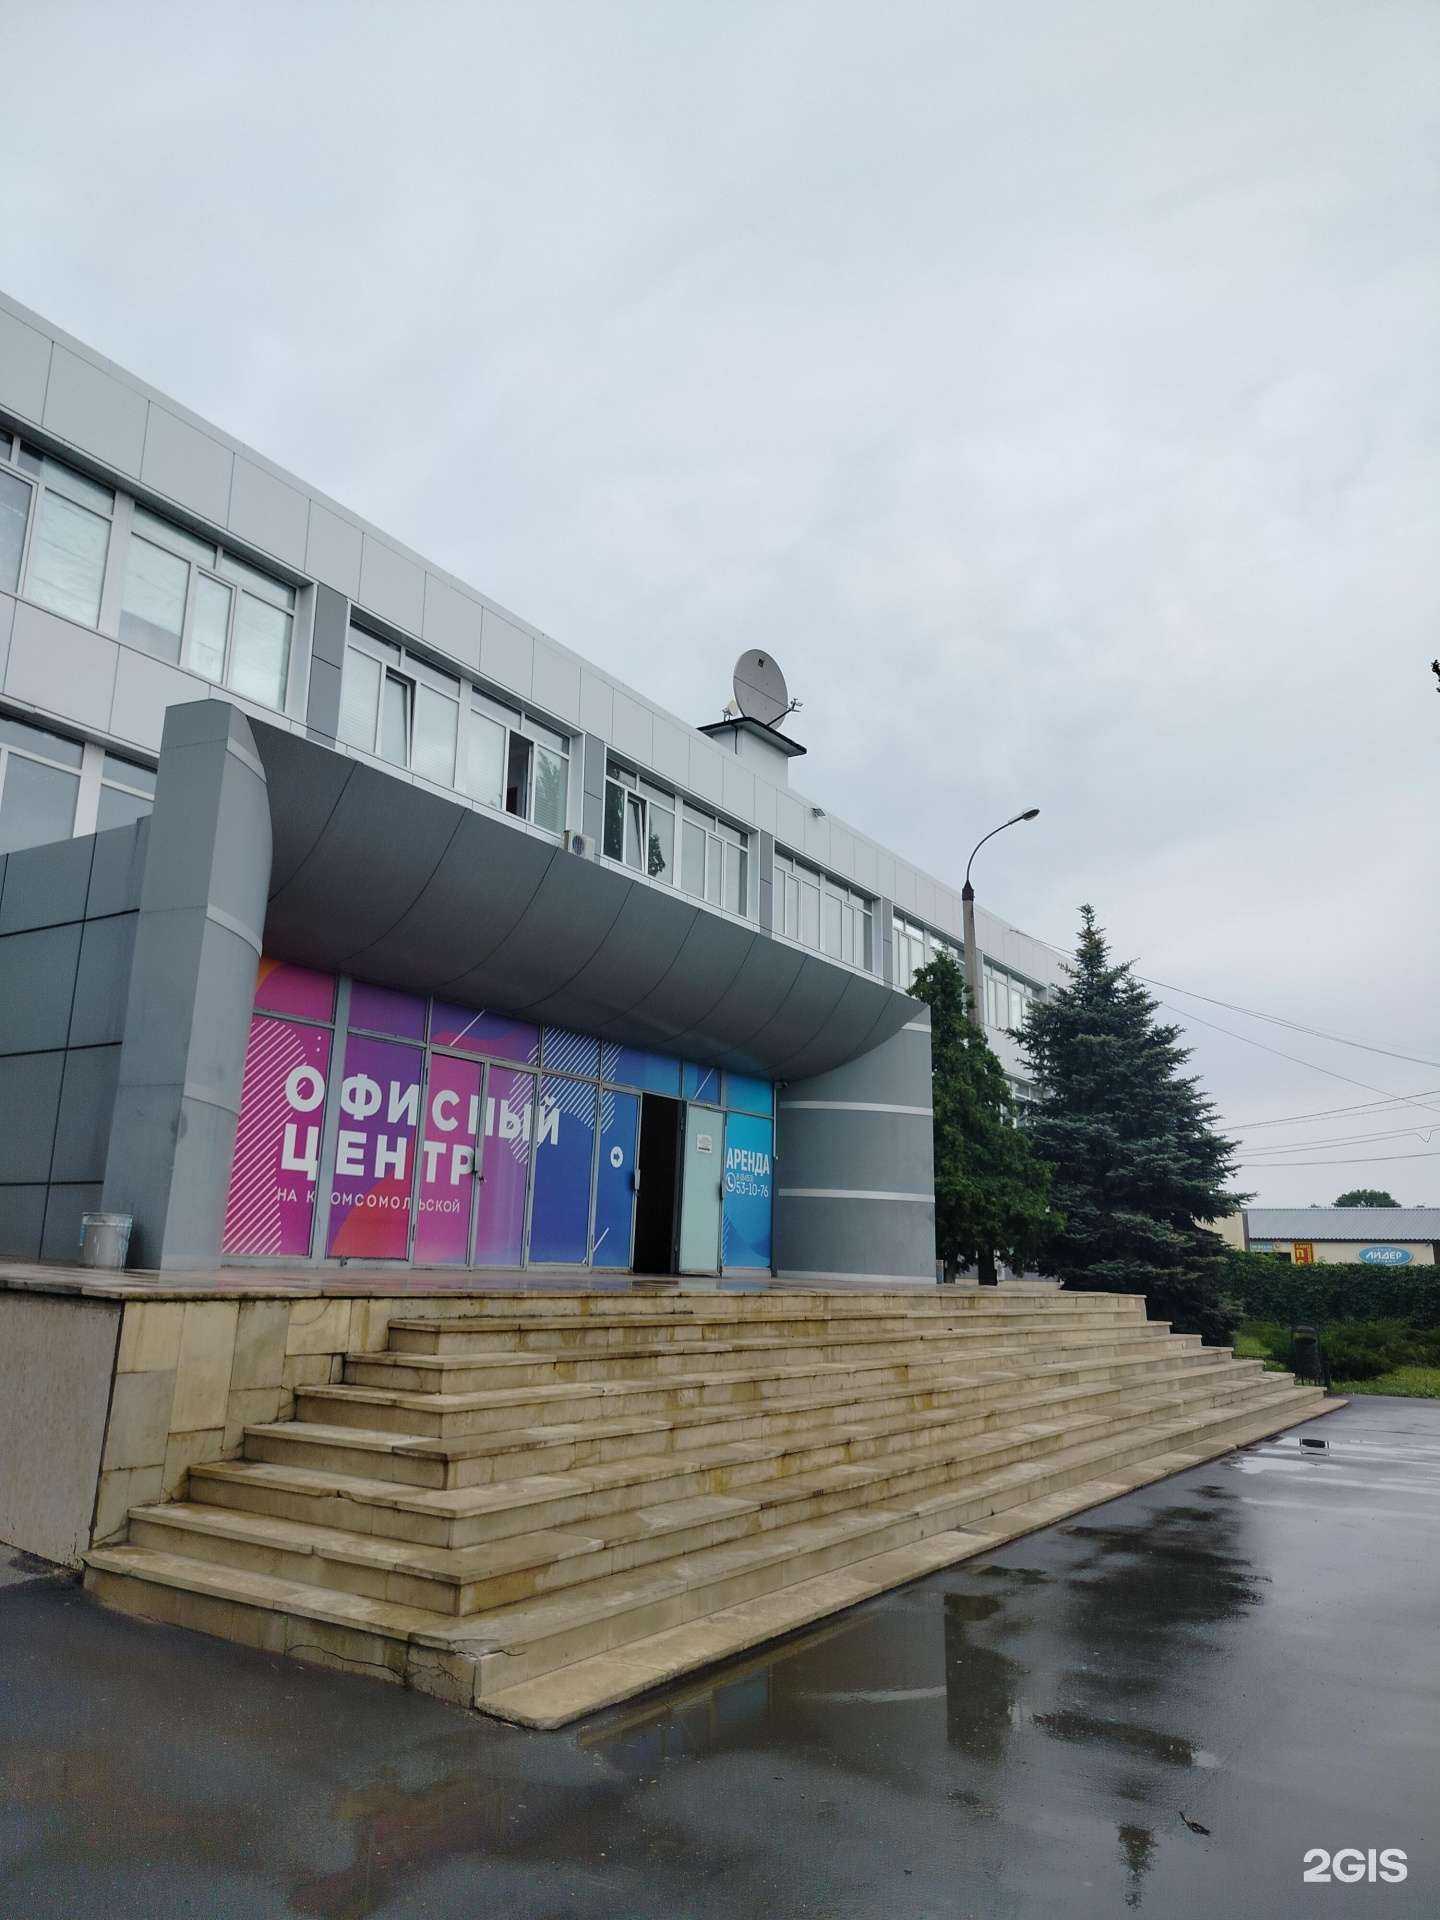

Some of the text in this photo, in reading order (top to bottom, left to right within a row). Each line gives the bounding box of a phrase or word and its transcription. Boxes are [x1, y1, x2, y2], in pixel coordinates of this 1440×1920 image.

[284, 1065, 560, 1146] ОФИСНЫЙ
[281, 1123, 476, 1186] ЦЕНТР
[726, 1147, 770, 1177] АРЕНДА
[276, 1187, 460, 1212] НА КОМСОМОЛЬСКОЙ
[736, 1181, 769, 1198] 53-10-76
[1366, 1251, 1402, 1260] ЛИДЕР
